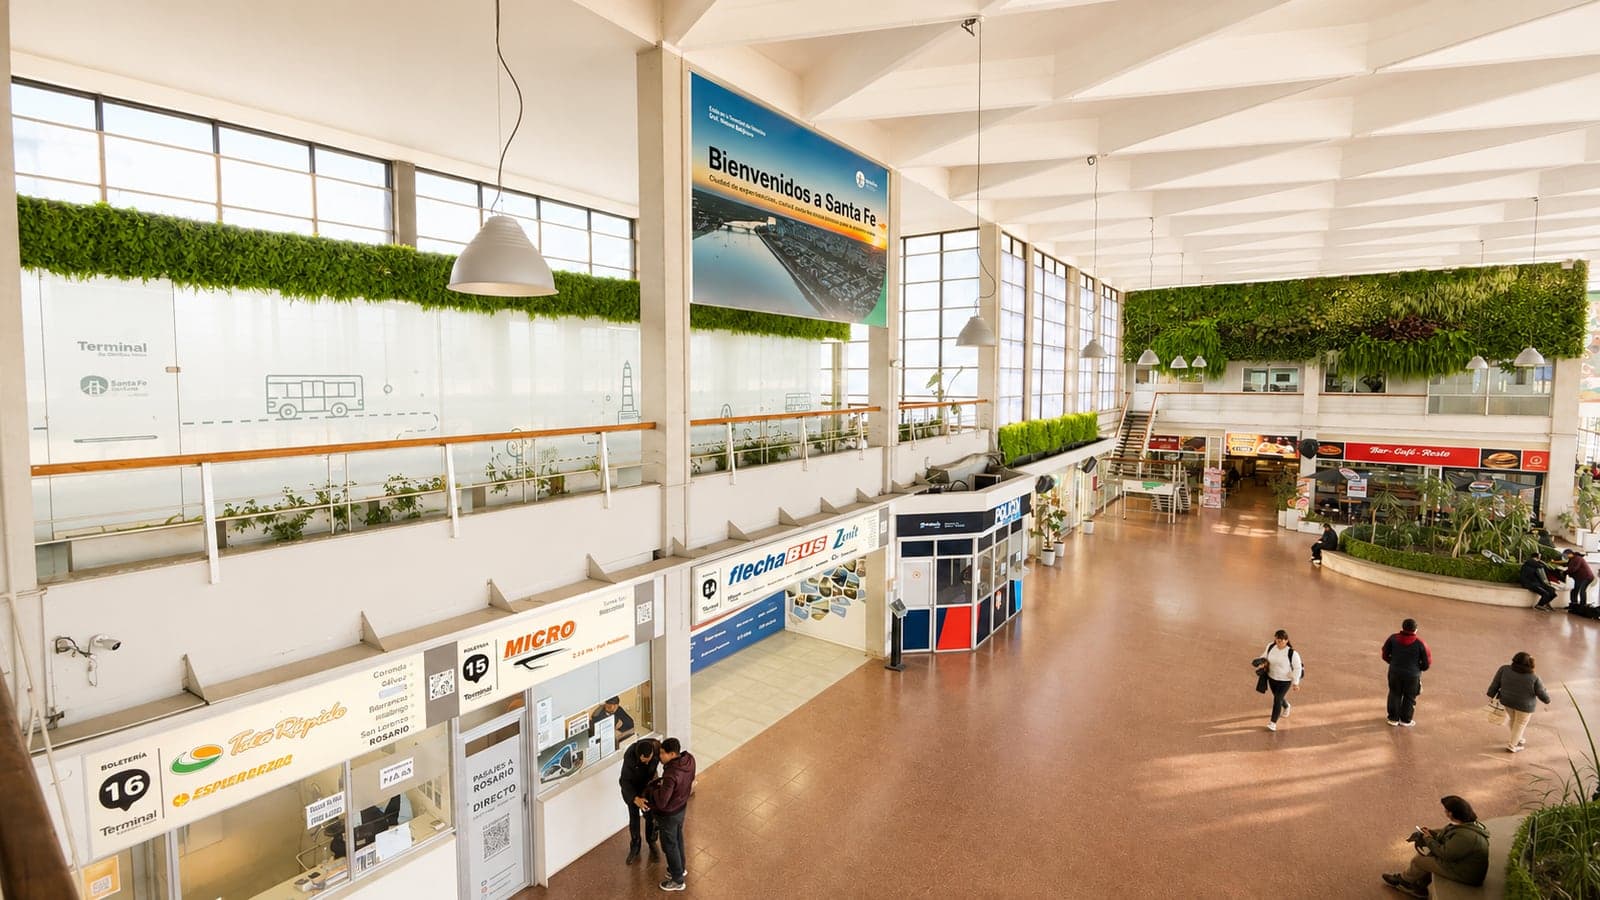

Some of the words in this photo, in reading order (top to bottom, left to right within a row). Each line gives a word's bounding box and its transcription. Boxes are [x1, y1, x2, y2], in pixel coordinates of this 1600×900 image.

[708, 146, 811, 203] Bienvenidos
[814, 193, 822, 208] a
[825, 193, 861, 221] Santa
[863, 207, 877, 227] Fe
[77, 341, 147, 353] Terminal
[1370, 446, 1388, 455] Bar
[1394, 447, 1416, 457] Café
[1421, 449, 1451, 458] Resto
[503, 620, 577, 660] MICRO
[466, 659, 486, 677] 15
[369, 725, 410, 746] ROSARIO
[101, 751, 147, 771] BOLETERÍA
[105, 775, 145, 802] 16
[473, 767, 514, 793] ROSARIO
[473, 784, 516, 812] DIRECTO
[100, 810, 157, 836] Terminal
